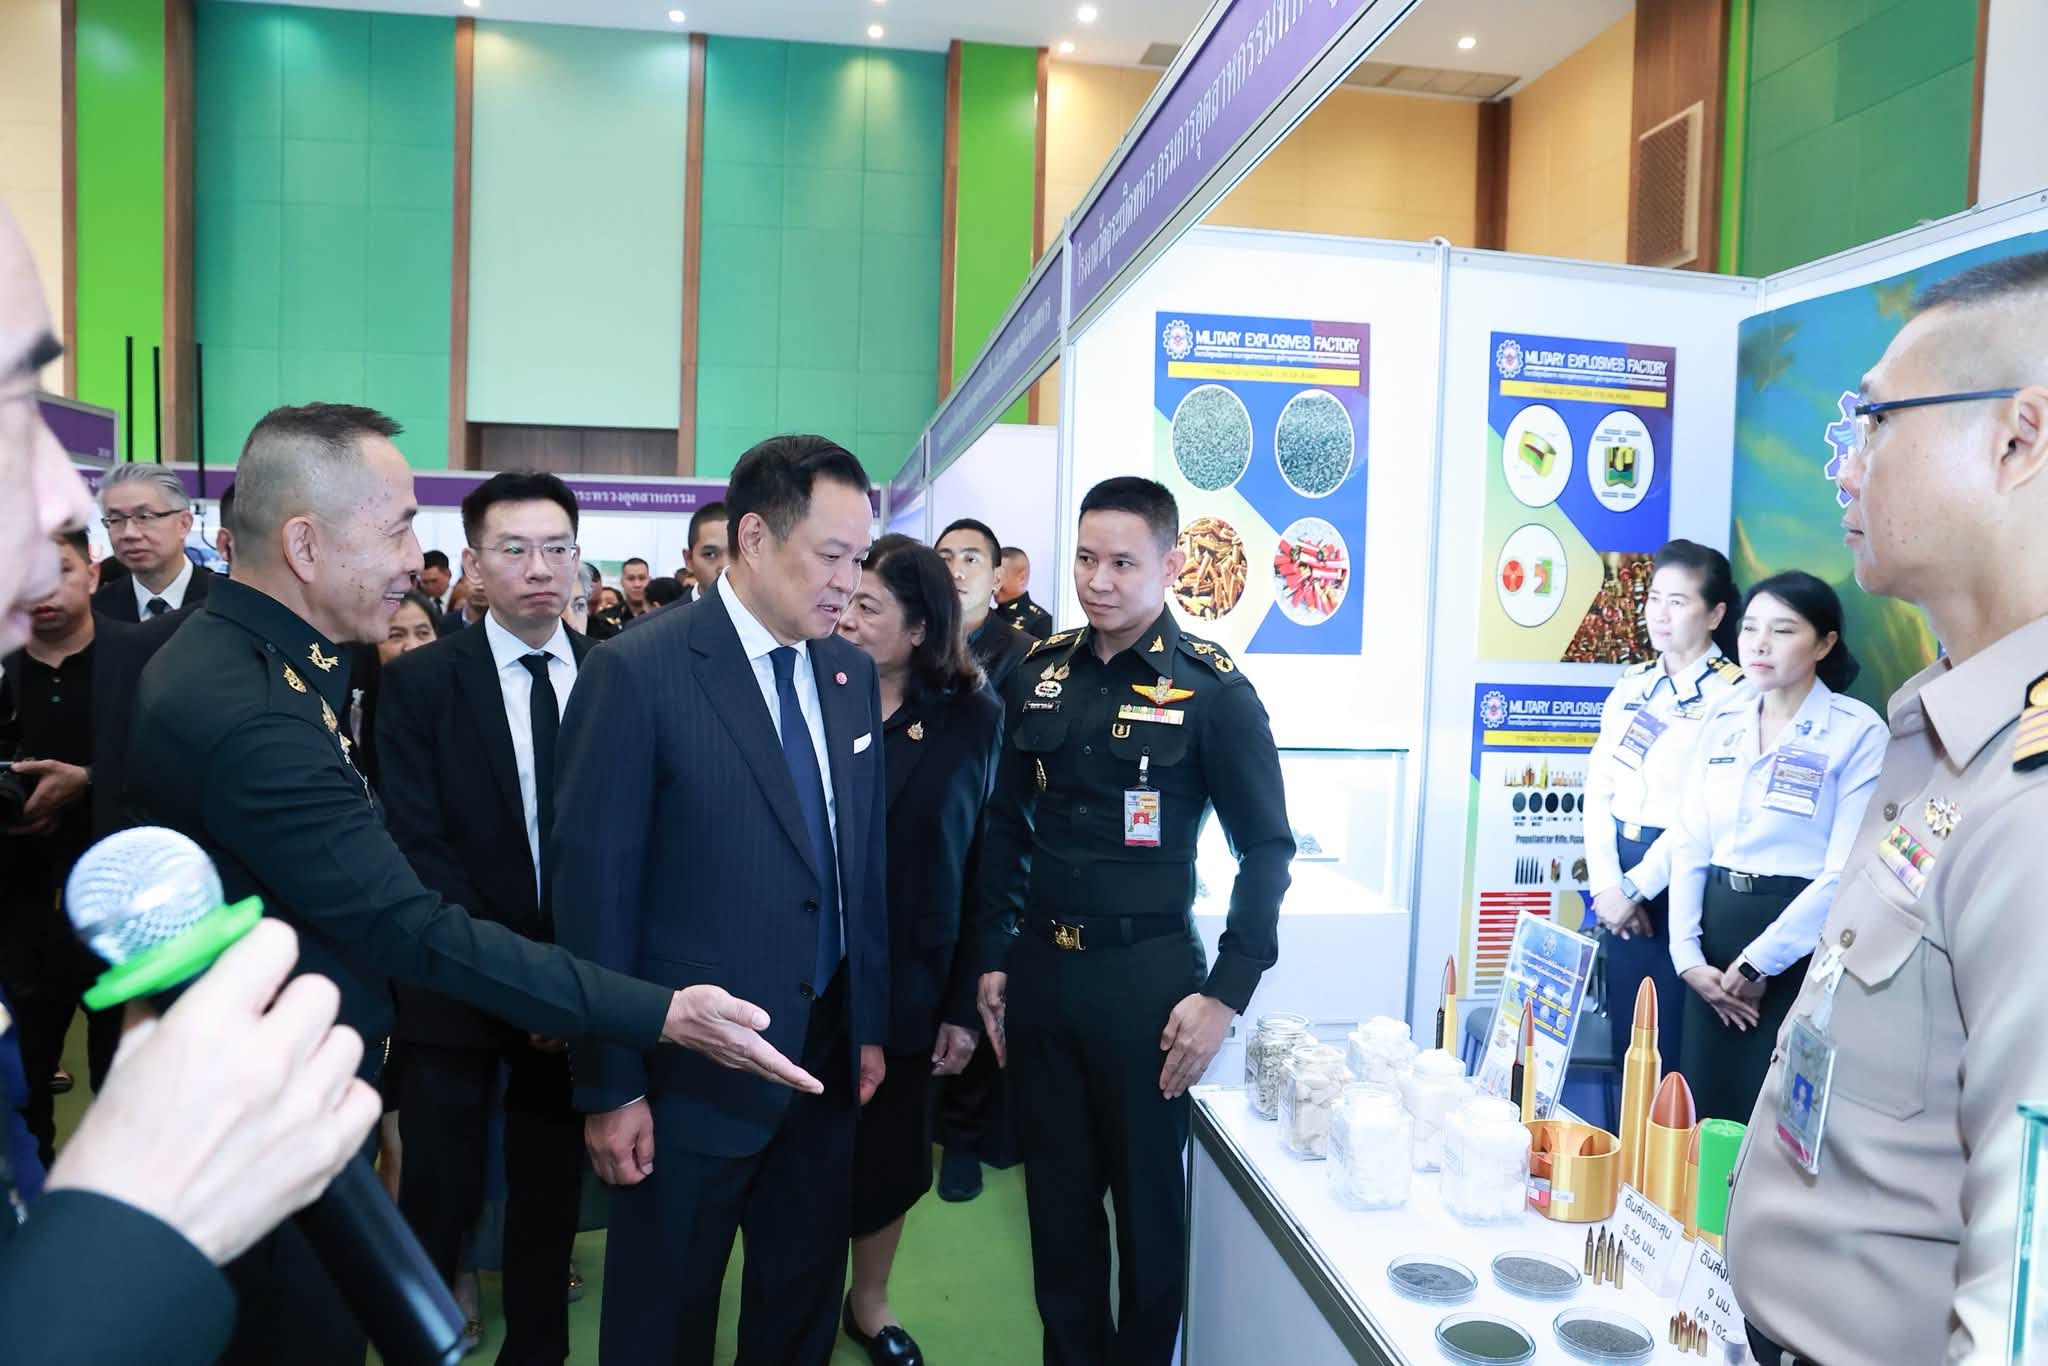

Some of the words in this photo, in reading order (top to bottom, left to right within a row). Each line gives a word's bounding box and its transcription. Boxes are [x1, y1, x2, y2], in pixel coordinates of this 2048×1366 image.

[1195, 329, 1242, 346] MILITARY
[1244, 332, 1310, 350] EXPLOSIVES
[1313, 336, 1361, 353] FACTORY
[1524, 350, 1565, 366] MILITARY
[1567, 353, 1626, 371] EXPLOSIVES
[1627, 358, 1668, 375] FACTORY
[1508, 700, 1550, 714] MILITARY
[1552, 701, 1604, 715] EXPLOSIVE
[1622, 1223, 1641, 1246] 5.56
[1641, 1240, 1656, 1260] มม.
[1707, 1287, 1715, 1300] 9
[1715, 1296, 1731, 1317] มม.
